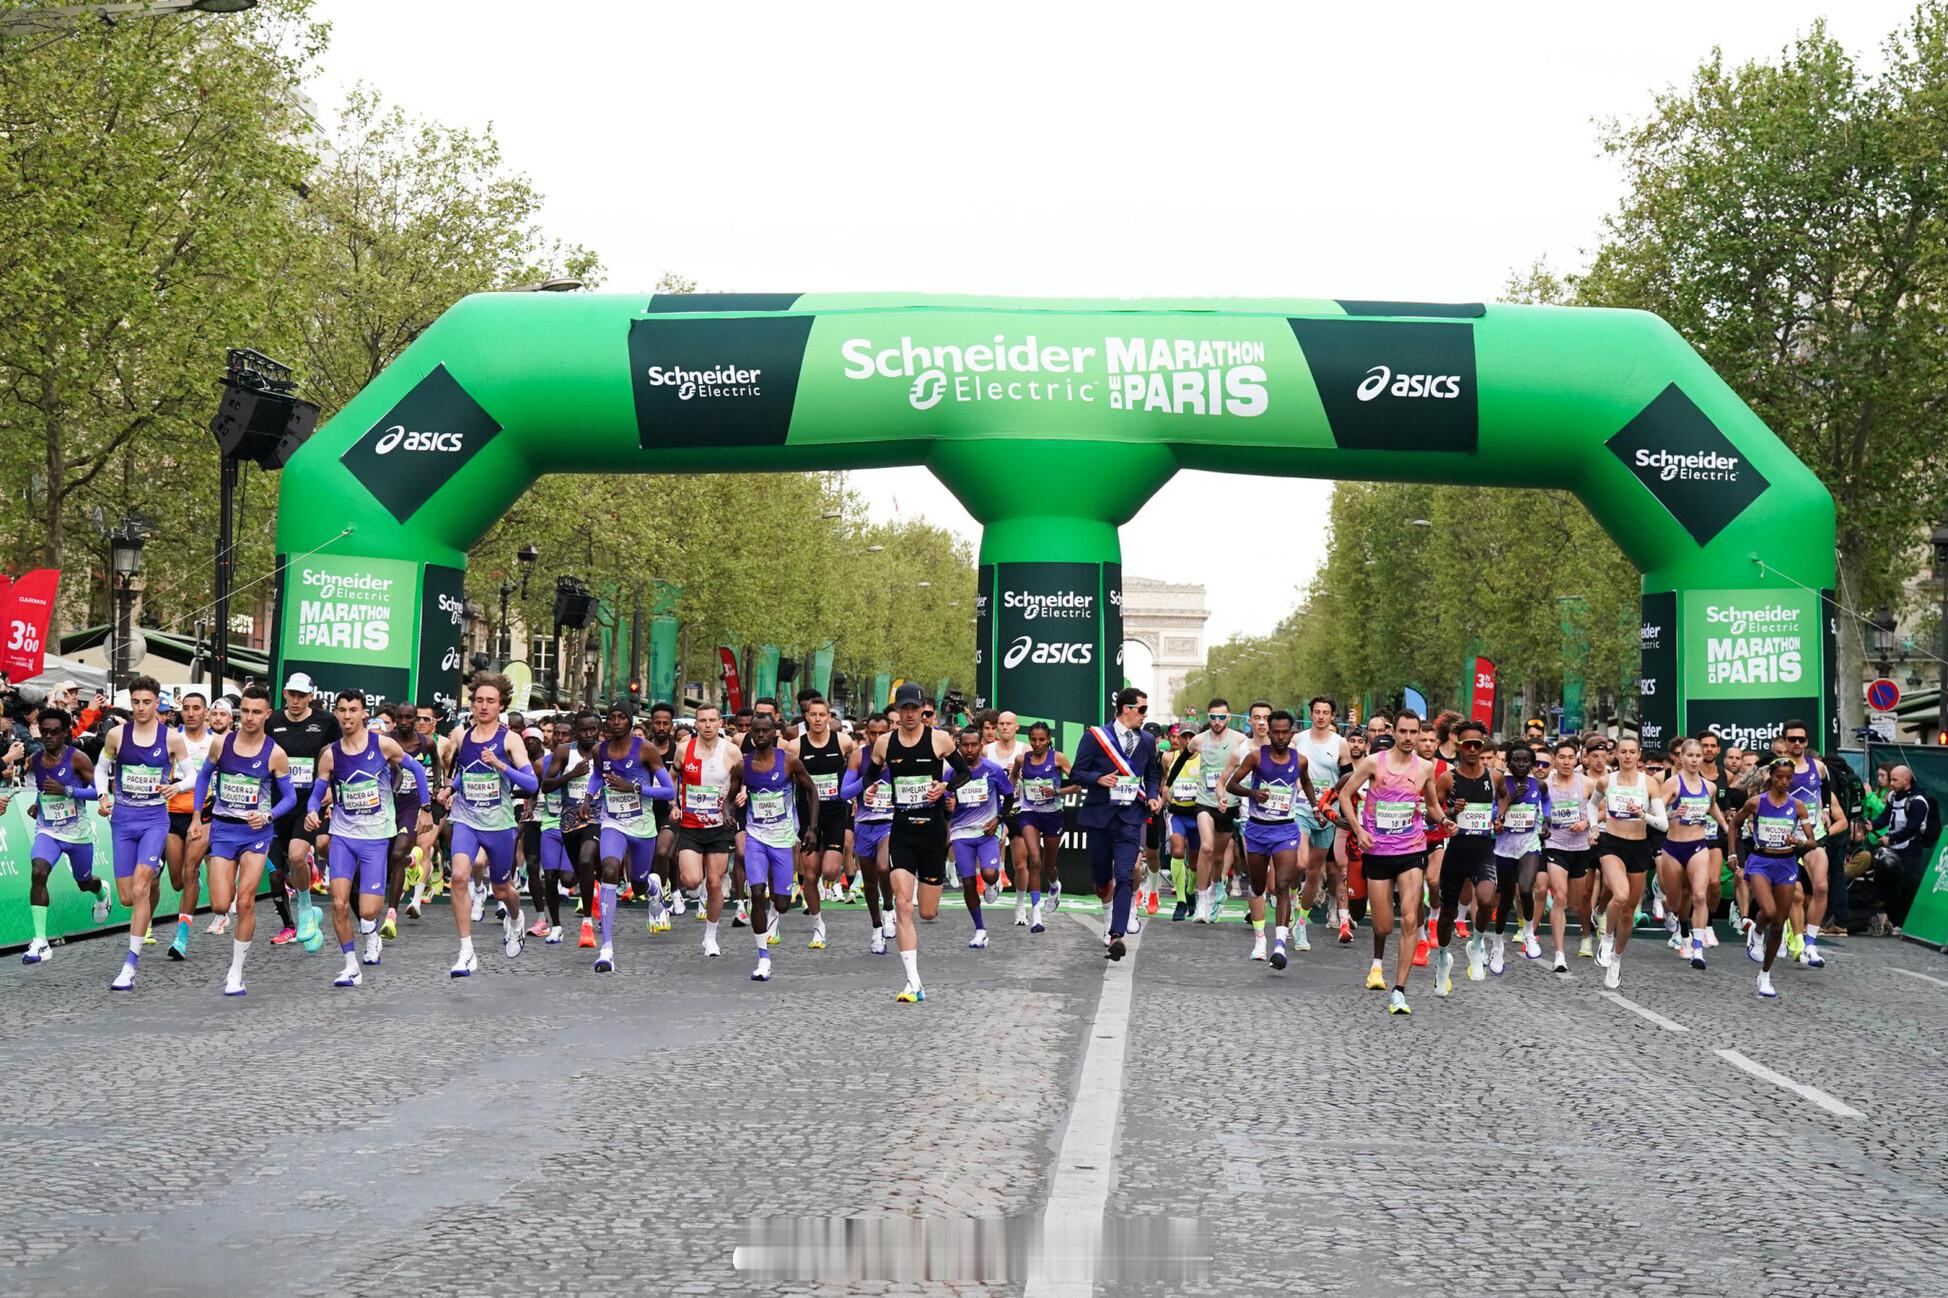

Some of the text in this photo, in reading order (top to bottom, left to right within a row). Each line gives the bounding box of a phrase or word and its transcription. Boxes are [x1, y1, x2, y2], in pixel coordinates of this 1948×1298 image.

[842, 335, 1097, 380] Schneider
[1105, 337, 1265, 374] MARATHON
[648, 364, 761, 386] Schneider
[699, 385, 761, 397] Electric
[954, 376, 1095, 402] Electric
[1108, 365, 1269, 417] DE PARIS
[1635, 449, 1739, 470] Schneider
[1680, 468, 1738, 482] Electric
[303, 569, 393, 592] Schneider
[19, 596, 47, 606] GARMIN
[336, 587, 390, 602] Electric
[1004, 591, 1093, 608] Schneider
[301, 600, 391, 625] MARATHON
[1041, 607, 1092, 619] Electric
[1706, 604, 1800, 623] Schneider
[306, 621, 390, 650] PARIS
[1749, 622, 1799, 634] Electric
[1707, 636, 1800, 663] MARATHON
[1717, 652, 1802, 684] PARIS
[127, 776, 148, 784] PACER
[467, 783, 486, 791] PACER
[224, 784, 244, 793] PACER
[901, 784, 927, 794] WHELAN
[346, 792, 366, 801] PACER
[696, 794, 707, 803] 87
[910, 795, 918, 803] 27
[1465, 812, 1486, 820] CRIPPA
